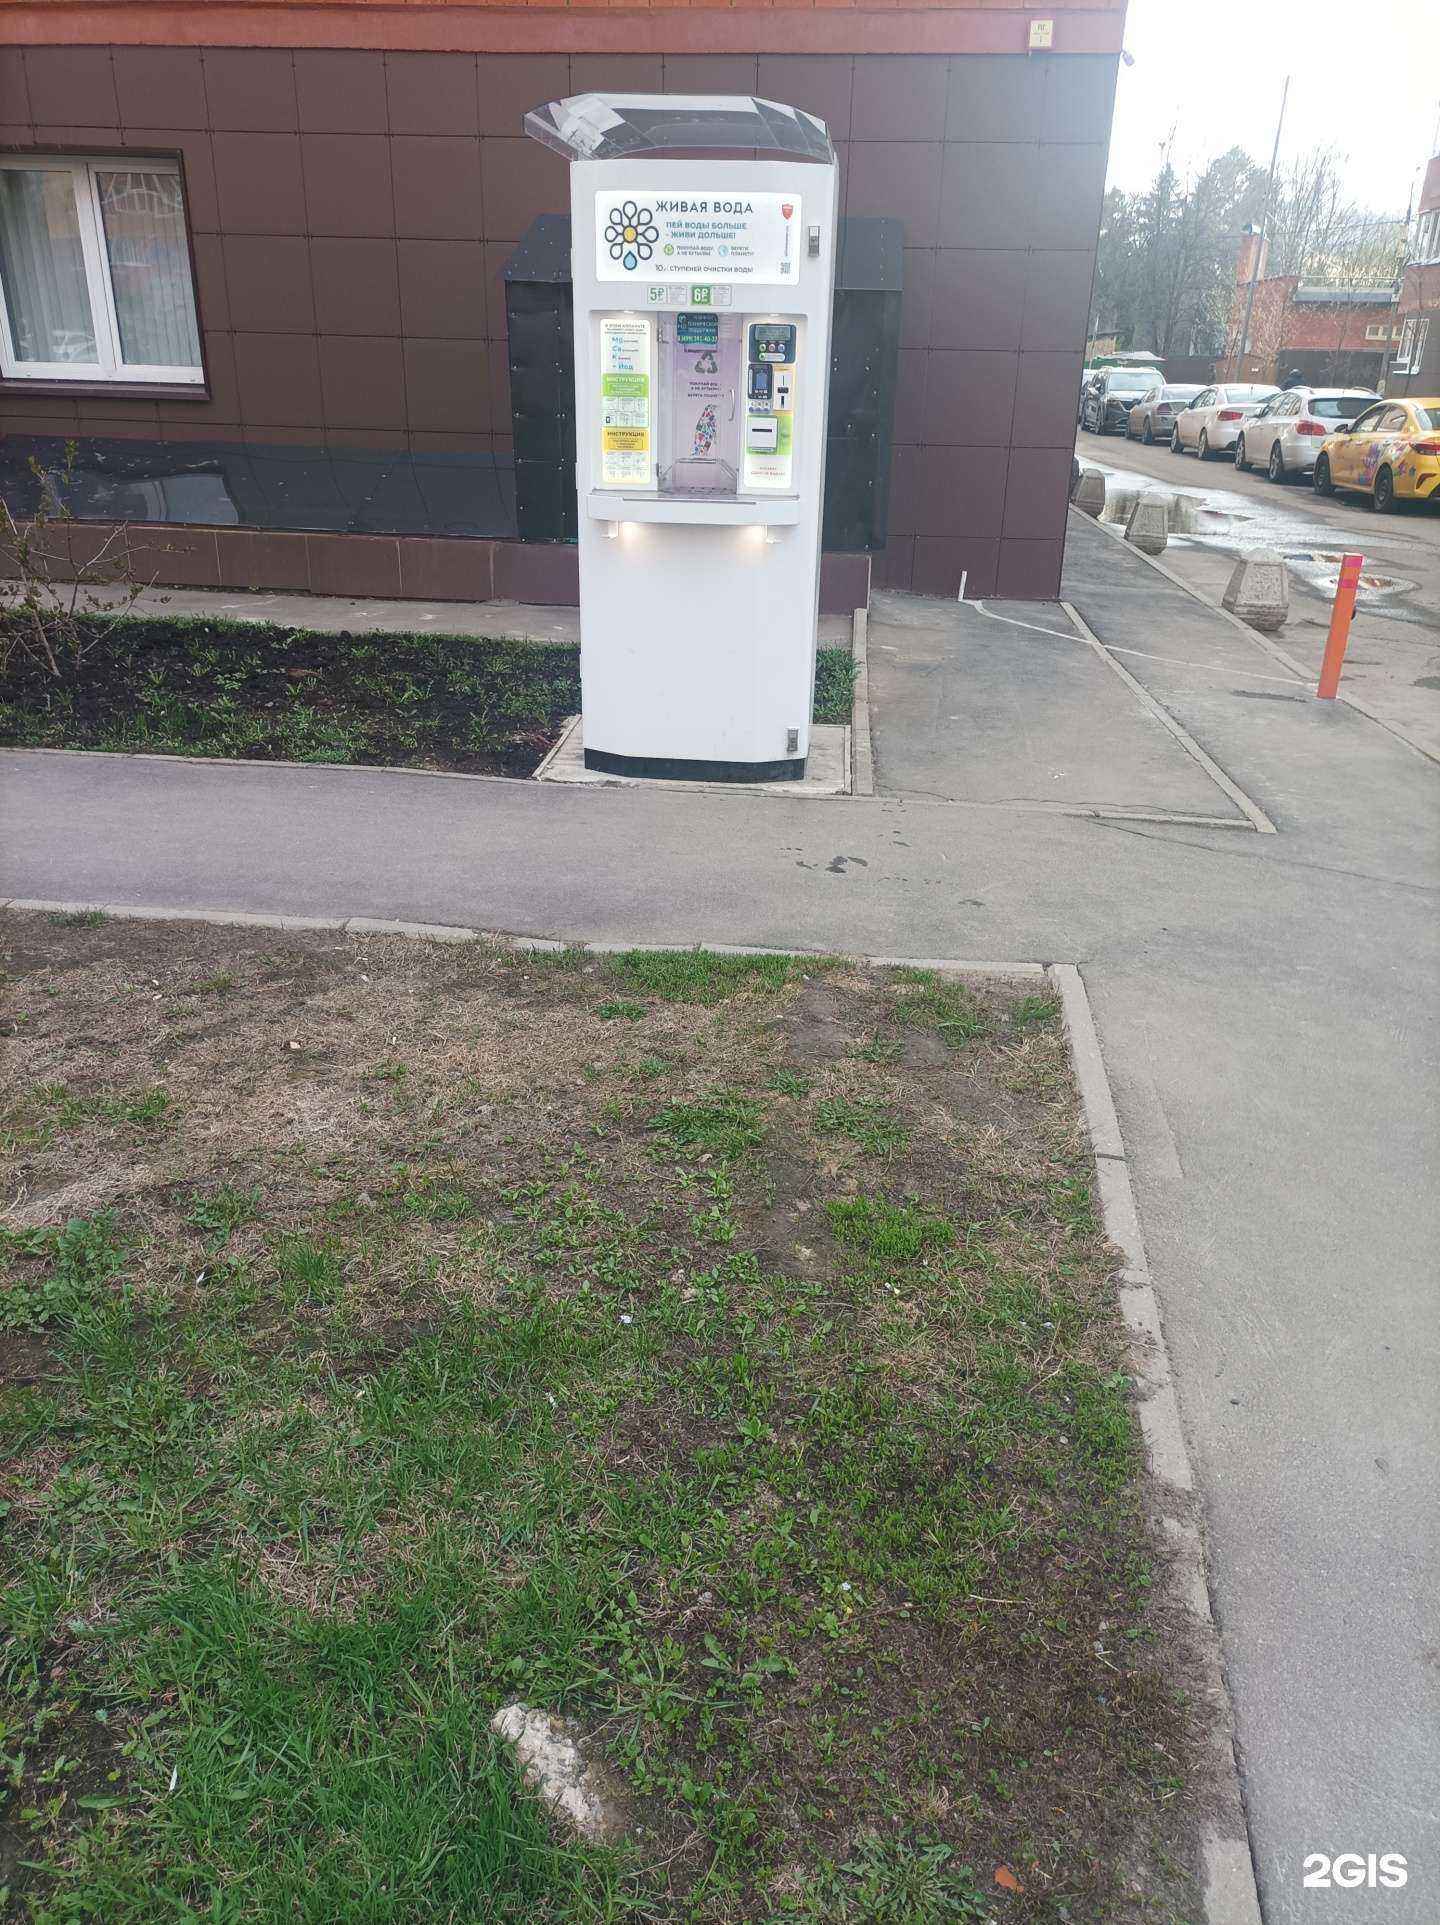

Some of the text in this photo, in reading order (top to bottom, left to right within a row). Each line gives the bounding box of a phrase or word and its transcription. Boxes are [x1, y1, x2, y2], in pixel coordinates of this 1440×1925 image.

[655, 201, 754, 215] ЖИВАЯ ВОДА
[666, 221, 747, 230] ПЕЙ ВОДЫ БОЛЬШЕ
[671, 231, 696, 239] ЖИВИ
[669, 264, 702, 272] СТУПЕНЕЙ
[703, 264, 733, 273] ОЧИСТКИ
[734, 266, 754, 274] ВОДЫ
